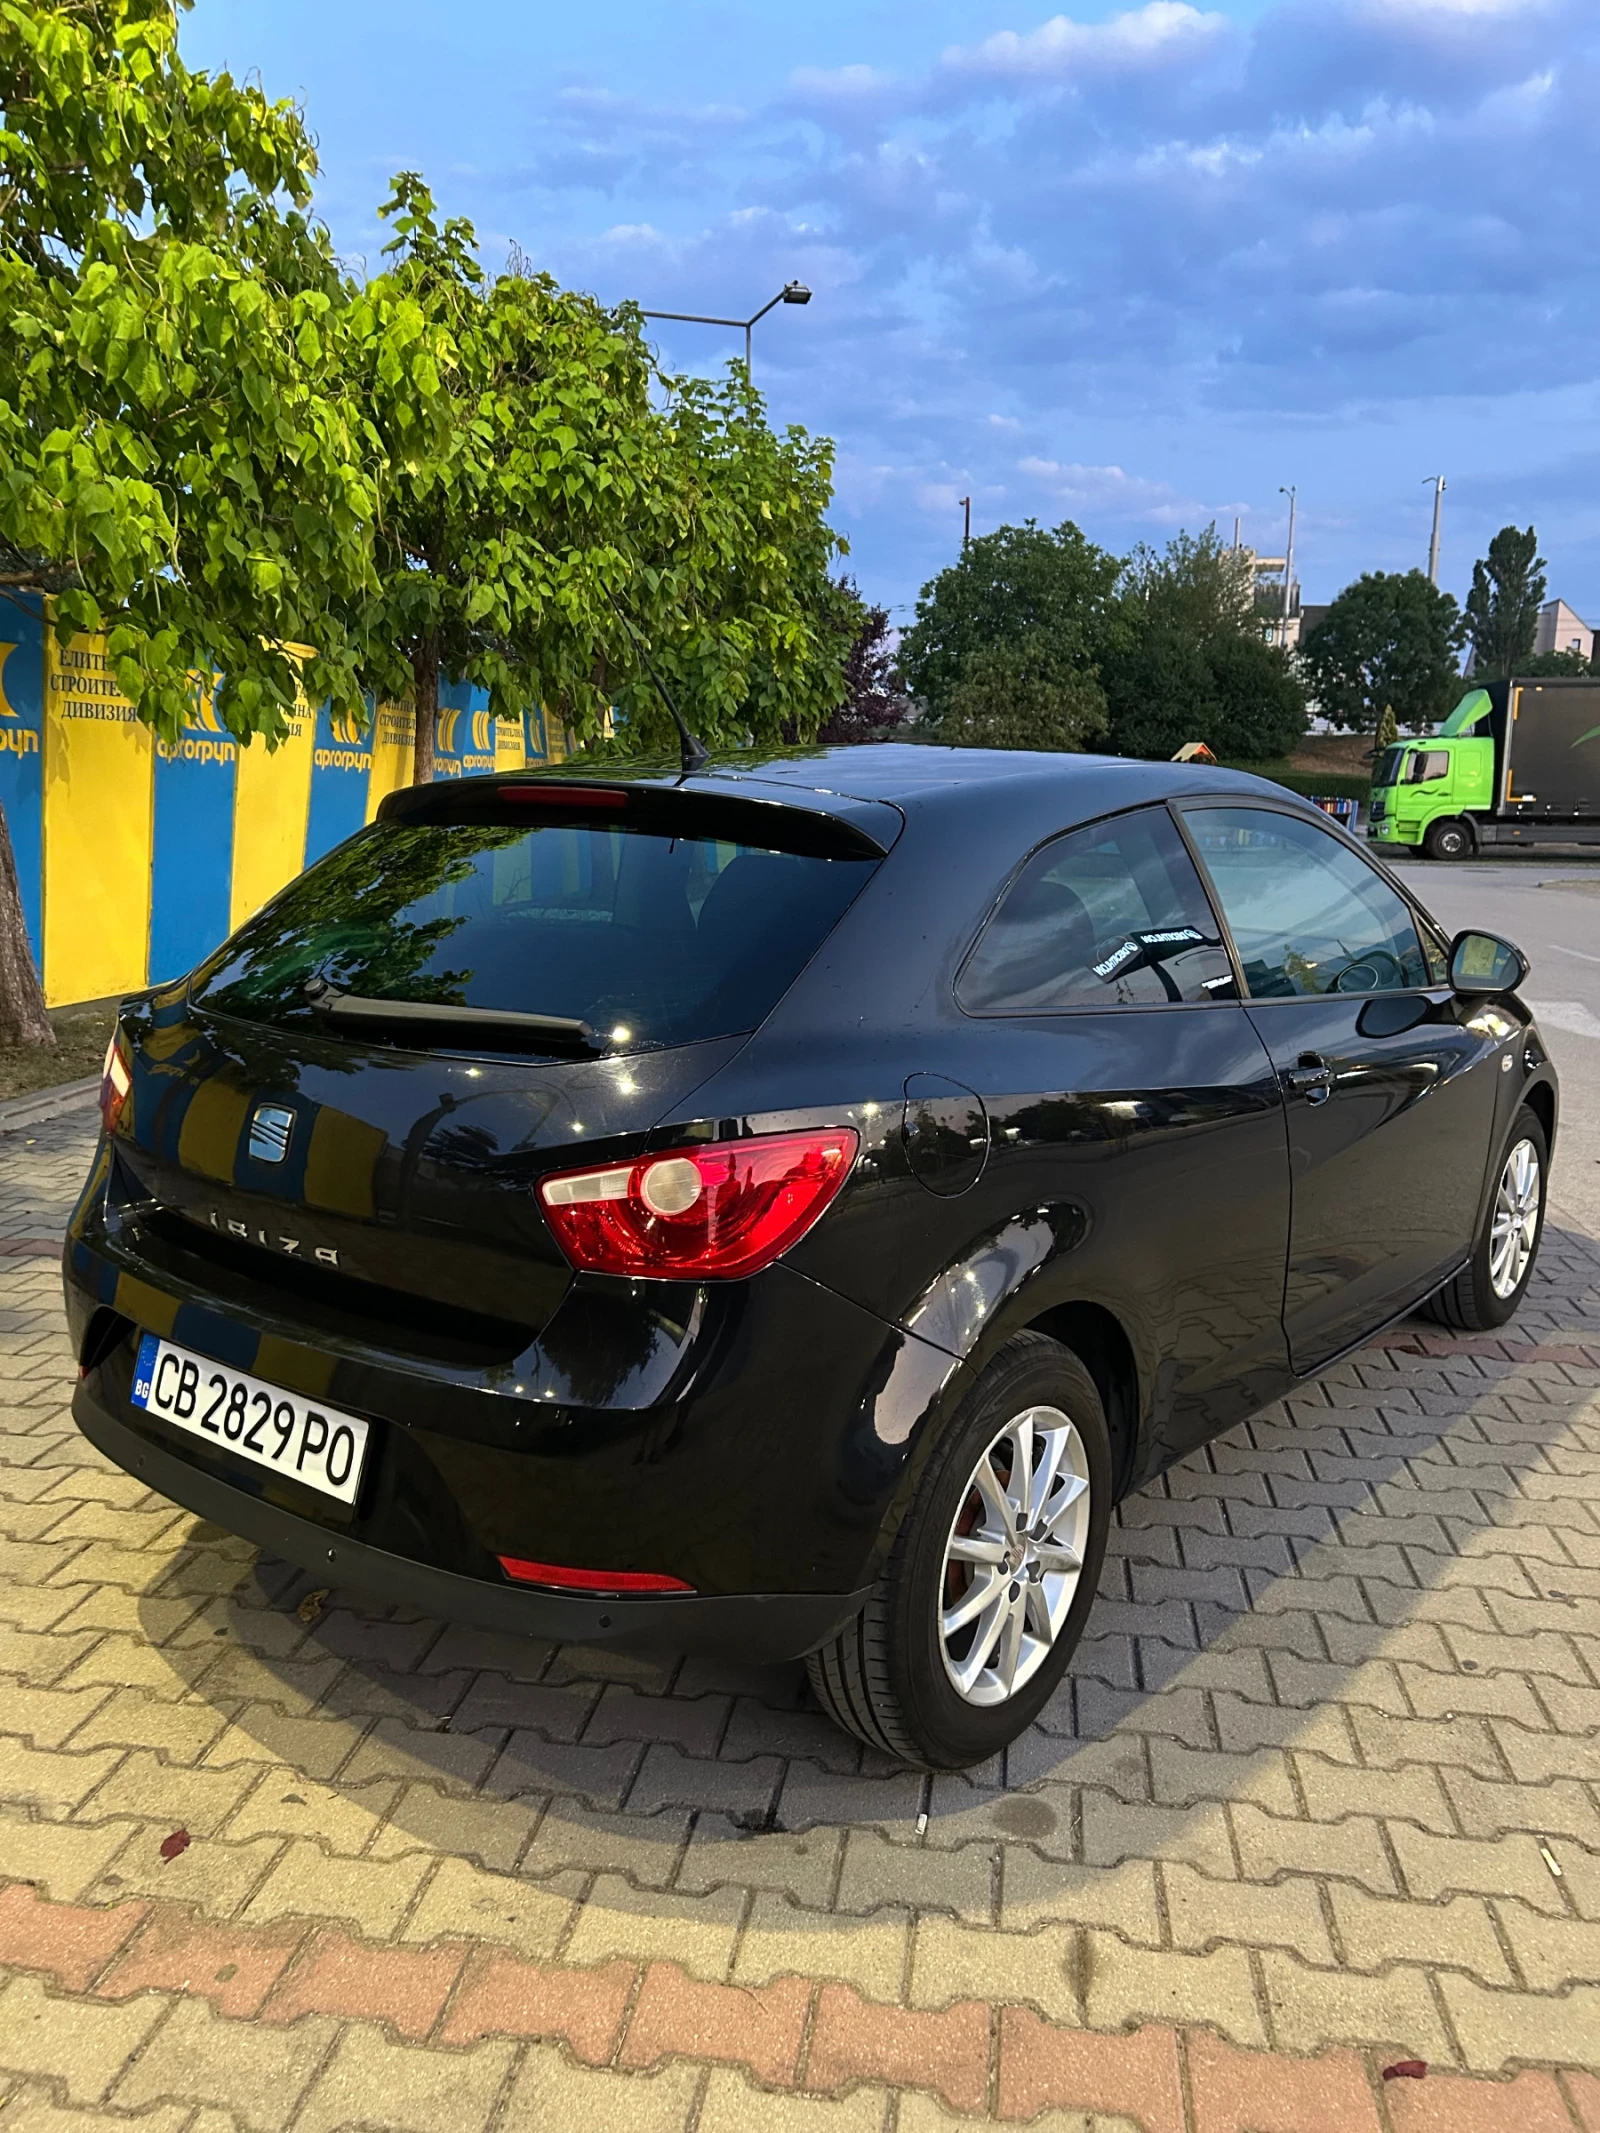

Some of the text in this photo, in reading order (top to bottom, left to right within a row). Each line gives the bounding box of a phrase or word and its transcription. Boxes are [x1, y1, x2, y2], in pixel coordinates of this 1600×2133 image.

[61, 700, 138, 722] ДИВИЗИЯ
[314, 748, 372, 773] аргогруп
[209, 1211, 340, 1267] IBIZA
[134, 1378, 150, 1399] BG
[200, 1374, 296, 1460] 2829
